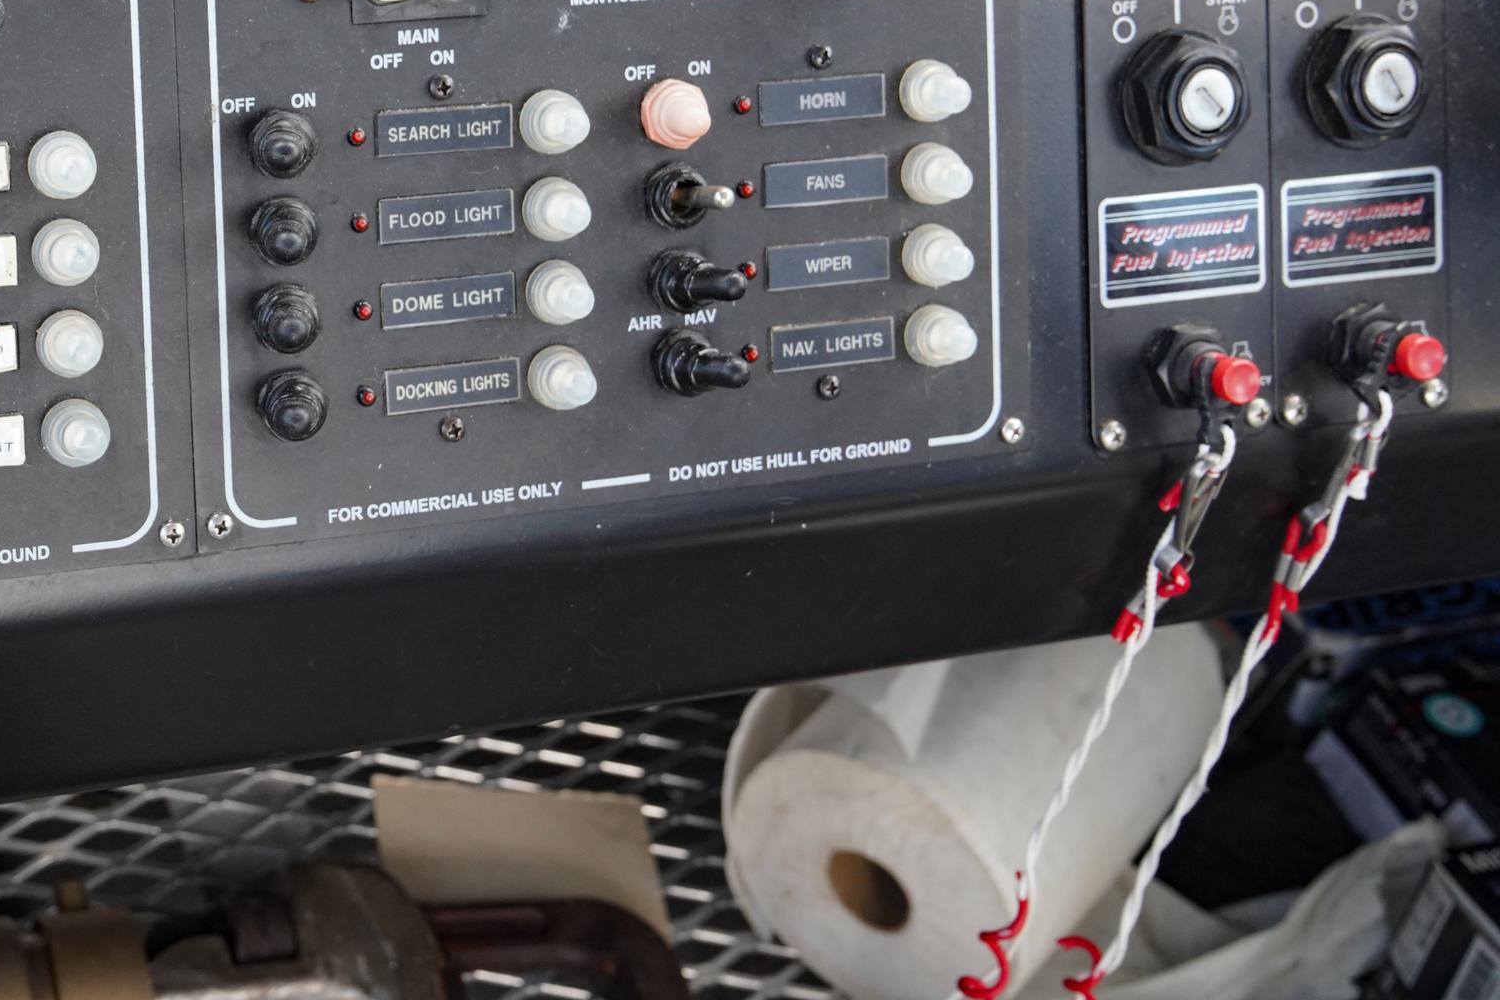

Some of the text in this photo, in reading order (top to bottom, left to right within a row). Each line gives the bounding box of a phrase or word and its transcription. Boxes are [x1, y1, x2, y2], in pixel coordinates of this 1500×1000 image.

[1112, 0, 1136, 15] OFF
[398, 28, 439, 45] MAIN
[371, 50, 454, 69] OFF ON
[625, 60, 710, 81] OFF ON
[222, 93, 316, 113] OFF ON
[800, 92, 845, 109] HORN
[388, 120, 501, 142] SEARCH LIGHT
[807, 174, 845, 190] FANS
[390, 205, 502, 229] FLOOD LIGHT
[1303, 197, 1425, 229] Programmed
[1121, 214, 1249, 246] Programmed
[1293, 224, 1431, 256] Fuel Injection
[806, 256, 851, 273] WIPER
[1112, 243, 1255, 274] Fuel Injection
[393, 288, 503, 313] DOME LIGHT
[628, 309, 716, 331] AHR NAV
[782, 333, 883, 358] NAV. LIGHTS
[396, 373, 509, 400] DOCKING LIGHTS
[670, 439, 910, 481] DO NOT USE HULL FOR GROUND
[329, 482, 562, 523] FOR COMMERCIAL USE ONLY
